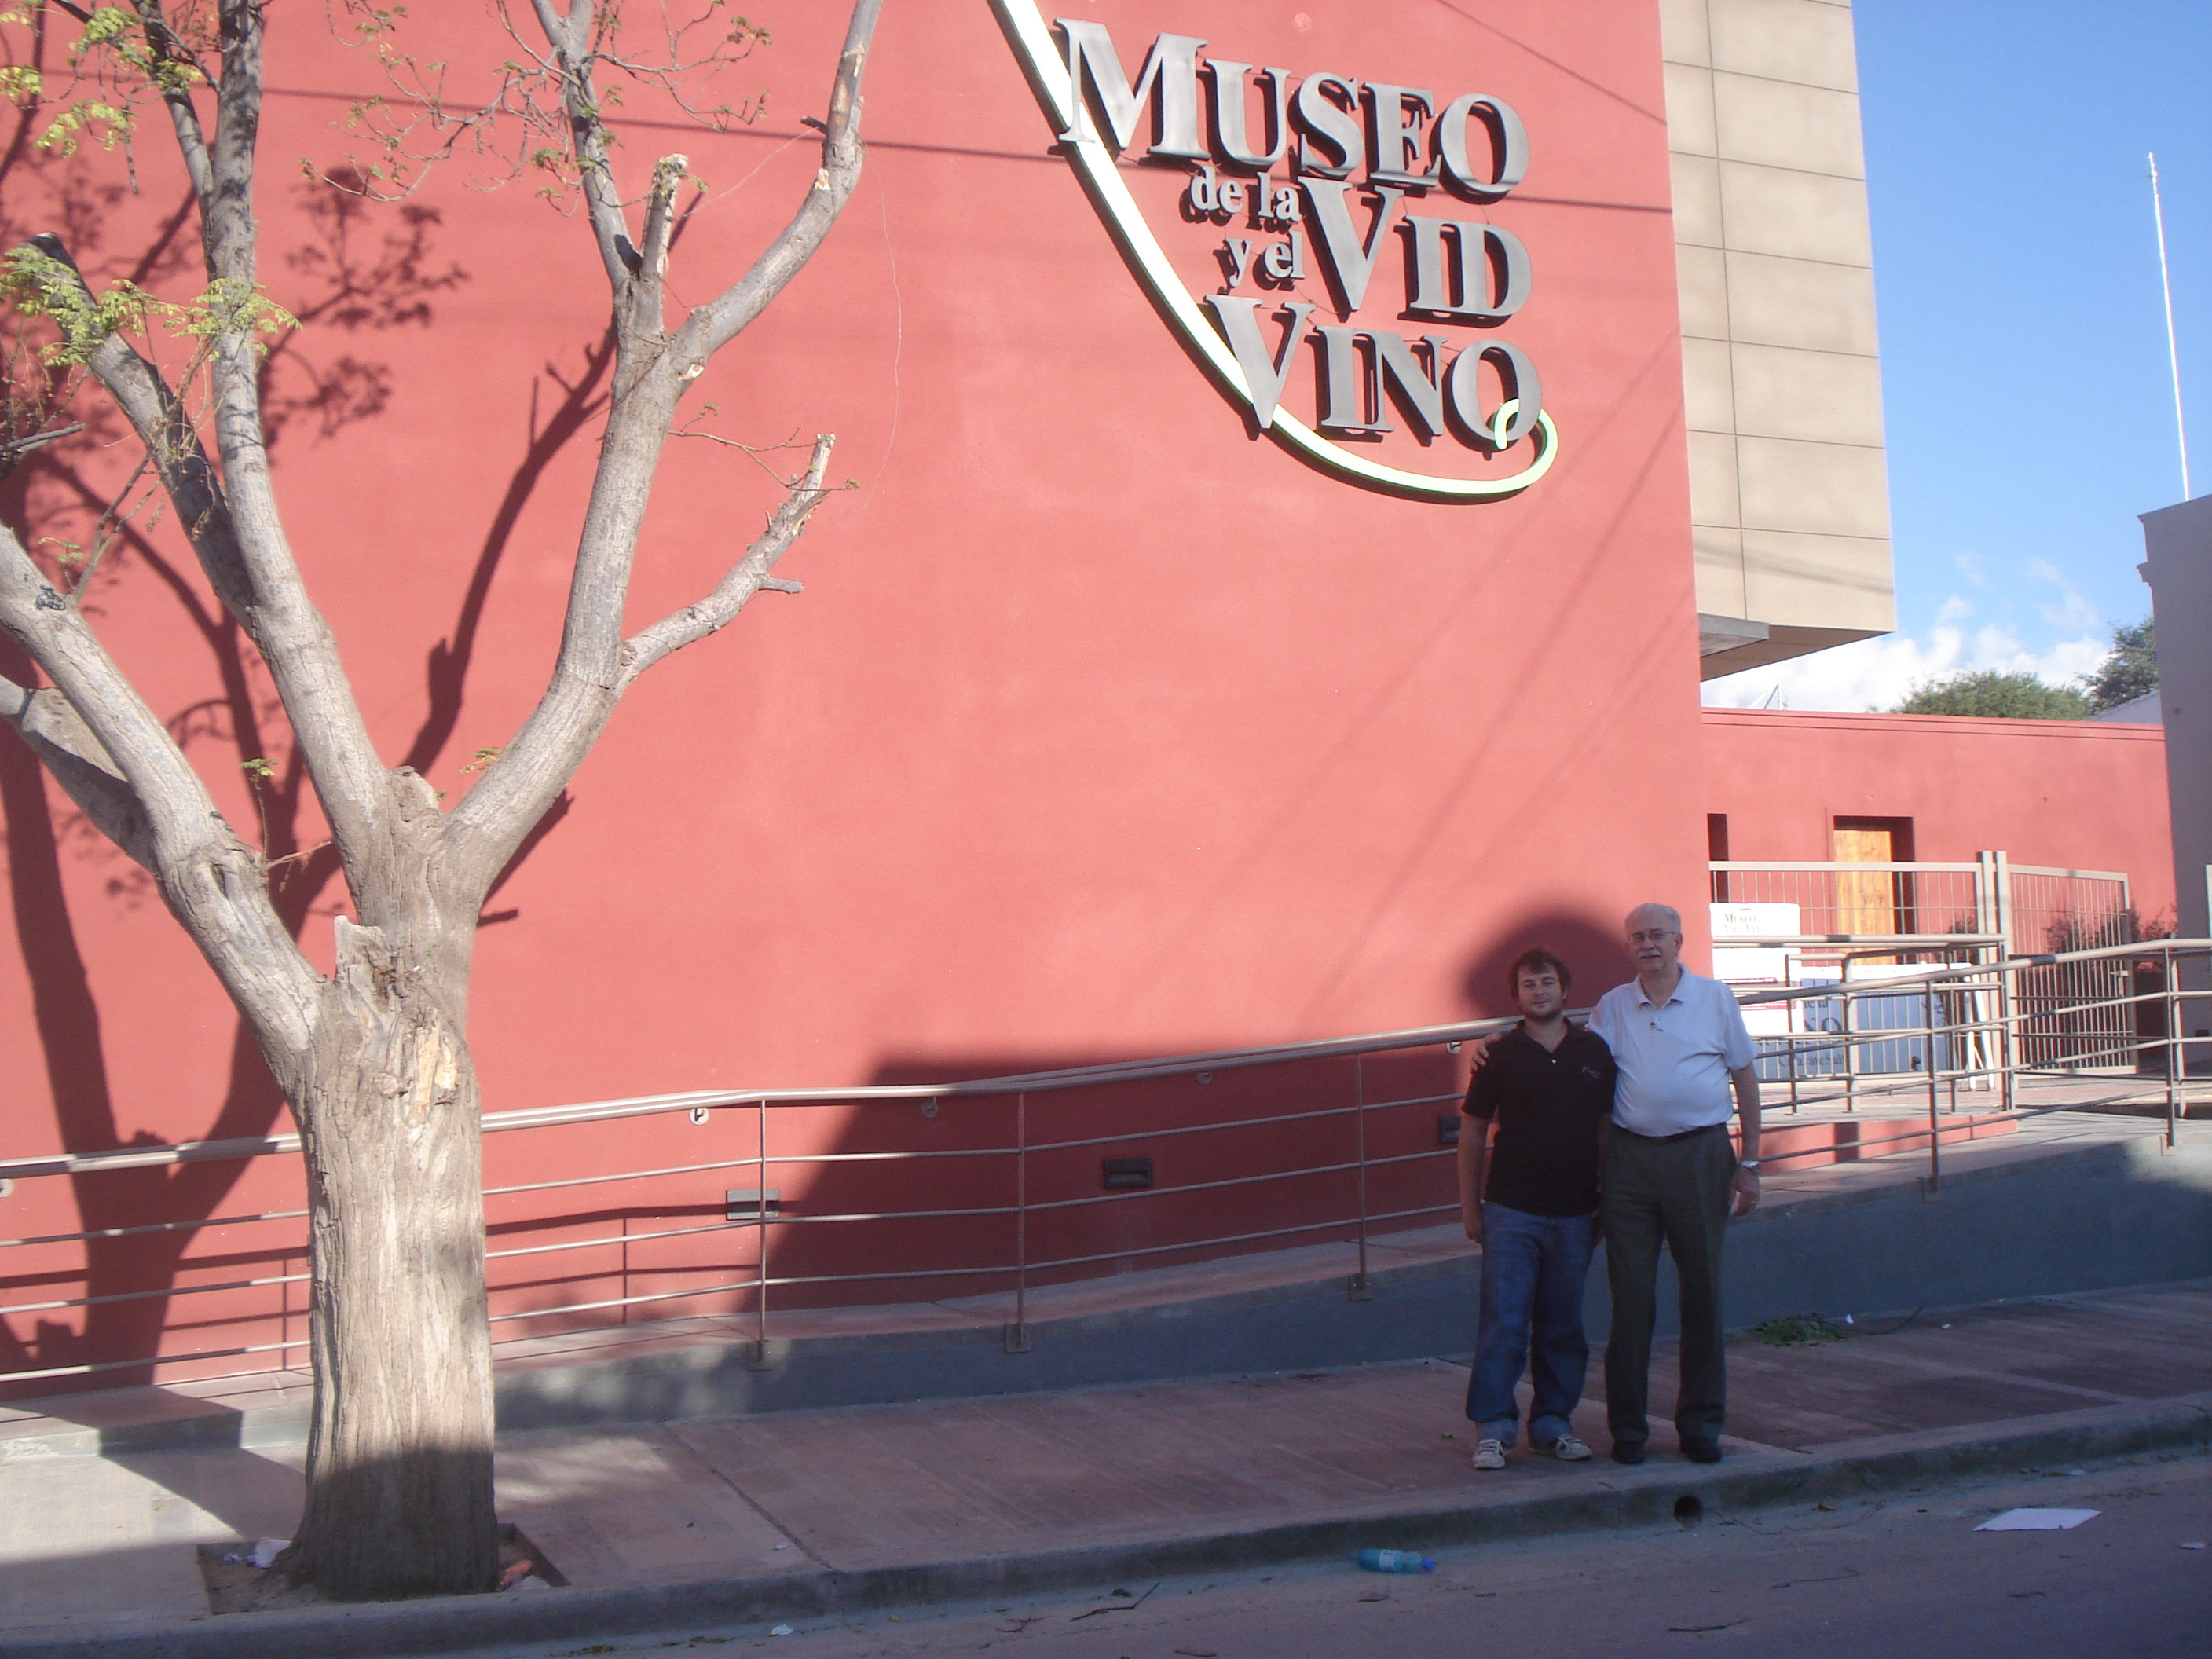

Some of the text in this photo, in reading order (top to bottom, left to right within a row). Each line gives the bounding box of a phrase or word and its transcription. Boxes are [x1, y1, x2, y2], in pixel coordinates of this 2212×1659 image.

[1053, 17, 1531, 194] MUSEO
[1191, 166, 1302, 222] de la
[1225, 230, 1306, 287] y el
[1297, 176, 1533, 317] VID
[1205, 294, 1543, 442] VINO
